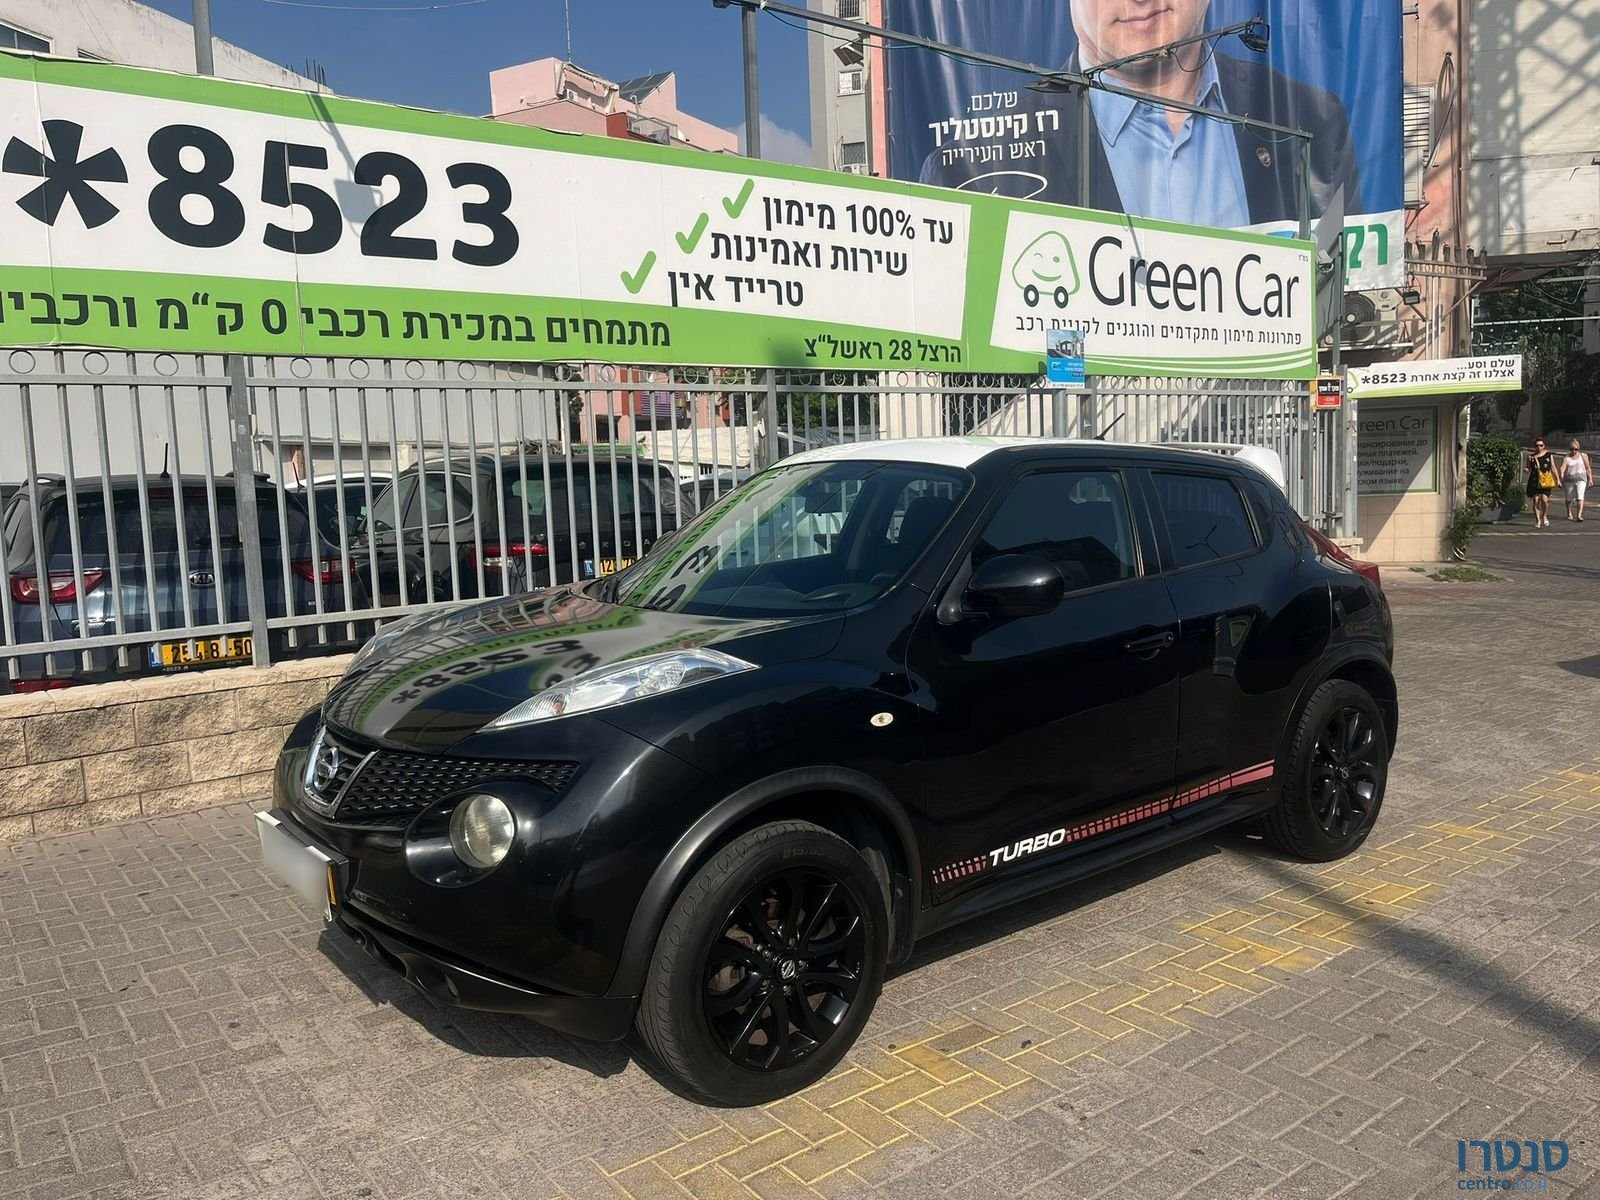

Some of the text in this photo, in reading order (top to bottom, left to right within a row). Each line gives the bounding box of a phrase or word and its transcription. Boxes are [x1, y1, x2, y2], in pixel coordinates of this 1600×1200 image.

[966, 91, 1018, 113] שלכם,
[928, 109, 1059, 147] רז קינסטליך
[942, 139, 1046, 166] ראש העירייה
[762, 196, 953, 245] עד 100% מימון
[711, 232, 908, 276] שירות ואמינות
[1088, 235, 1299, 318] Green Car
[667, 271, 804, 307] טרייד אין
[301, 307, 390, 338] רכבי
[402, 311, 536, 342] במכירת
[546, 317, 671, 347] מתמחים
[1016, 315, 1044, 332] רכב
[1106, 322, 1155, 338] והוגנים
[1160, 324, 1219, 343] מתקדמים
[1224, 328, 1253, 344] מימון
[1258, 330, 1301, 345] פתרונות
[888, 338, 912, 361] 28
[917, 339, 961, 363] הרצל
[1484, 368, 1515, 379] אצלנו
[1490, 358, 1515, 368] שלם
[1410, 373, 1440, 383] אחרת
[1443, 372, 1466, 381] קצת
[1469, 371, 1481, 379] זה
[1399, 415, 1429, 430] Car
[193, 574, 214, 584] KIA
[989, 828, 1066, 867] TURBO
